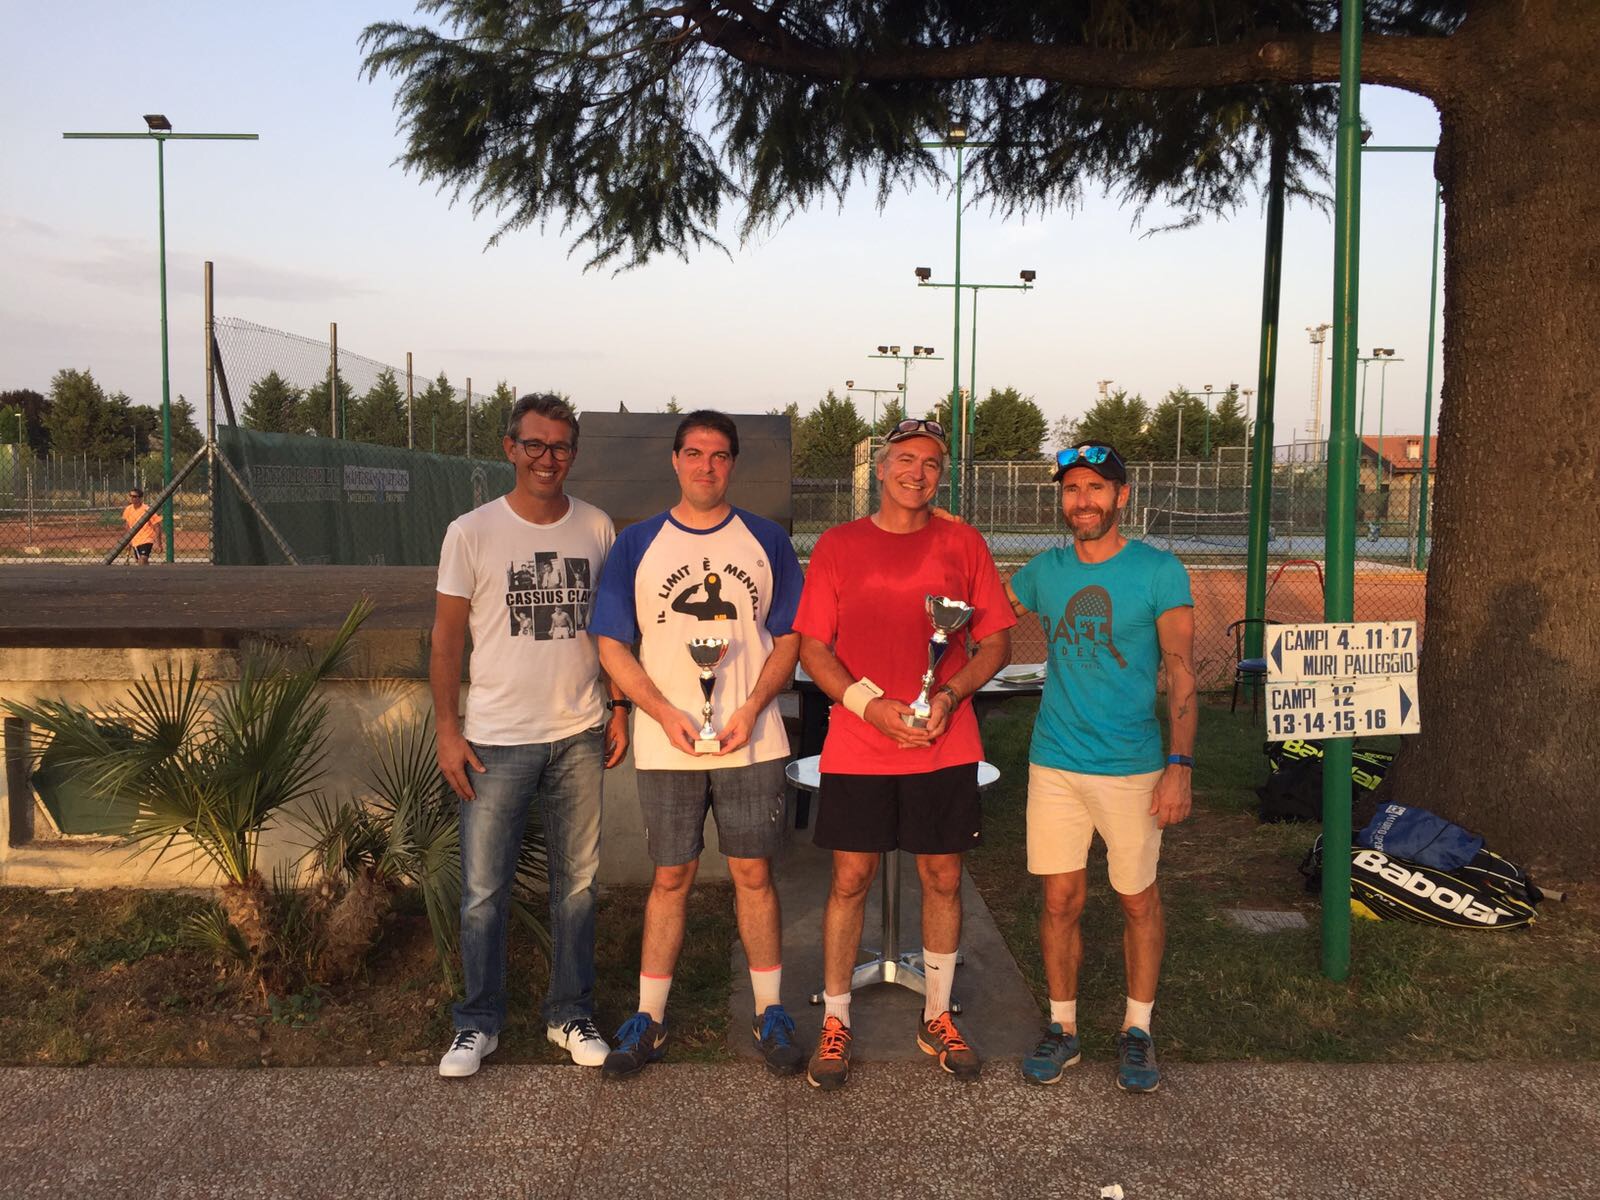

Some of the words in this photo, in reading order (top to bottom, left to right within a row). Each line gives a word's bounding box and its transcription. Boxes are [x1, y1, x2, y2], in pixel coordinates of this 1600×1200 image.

[703, 557, 711, 571] È
[505, 590, 563, 606] CASSIUS
[1285, 630, 1329, 651] CAMPI
[1303, 654, 1337, 676] MURI
[1344, 652, 1414, 675] PALLEGGIO
[1272, 688, 1316, 710] CAMPI
[1332, 686, 1354, 707] 12
